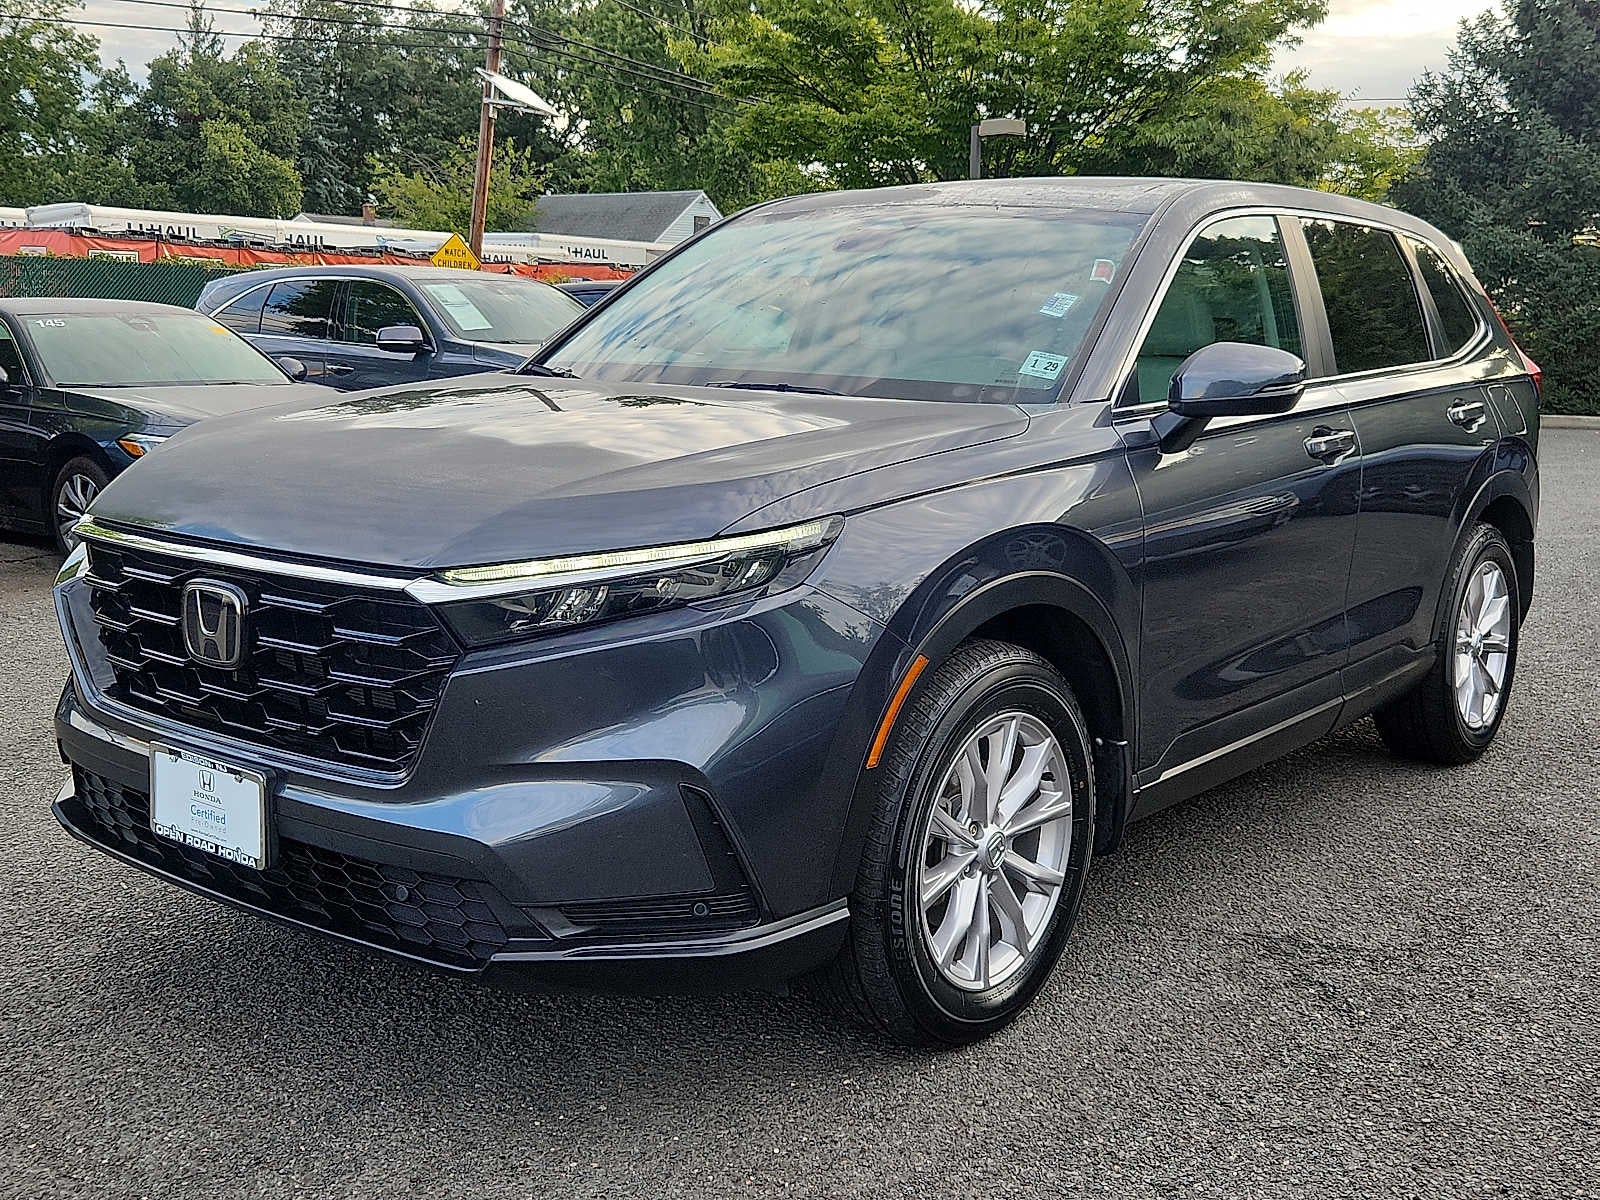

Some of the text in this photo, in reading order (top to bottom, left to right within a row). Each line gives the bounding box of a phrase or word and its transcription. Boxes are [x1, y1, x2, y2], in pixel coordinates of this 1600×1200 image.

[444, 248, 467, 258] WATCH
[437, 259, 472, 270] CHILDREN
[36, 319, 65, 328] 145
[1030, 359, 1059, 372] 1 29
[215, 763, 228, 773] NJ
[193, 790, 222, 805] HONDA
[190, 804, 226, 825] Certified
[155, 824, 184, 842] OPEN
[185, 835, 216, 853] ROAD
[217, 845, 257, 868] HONDA
